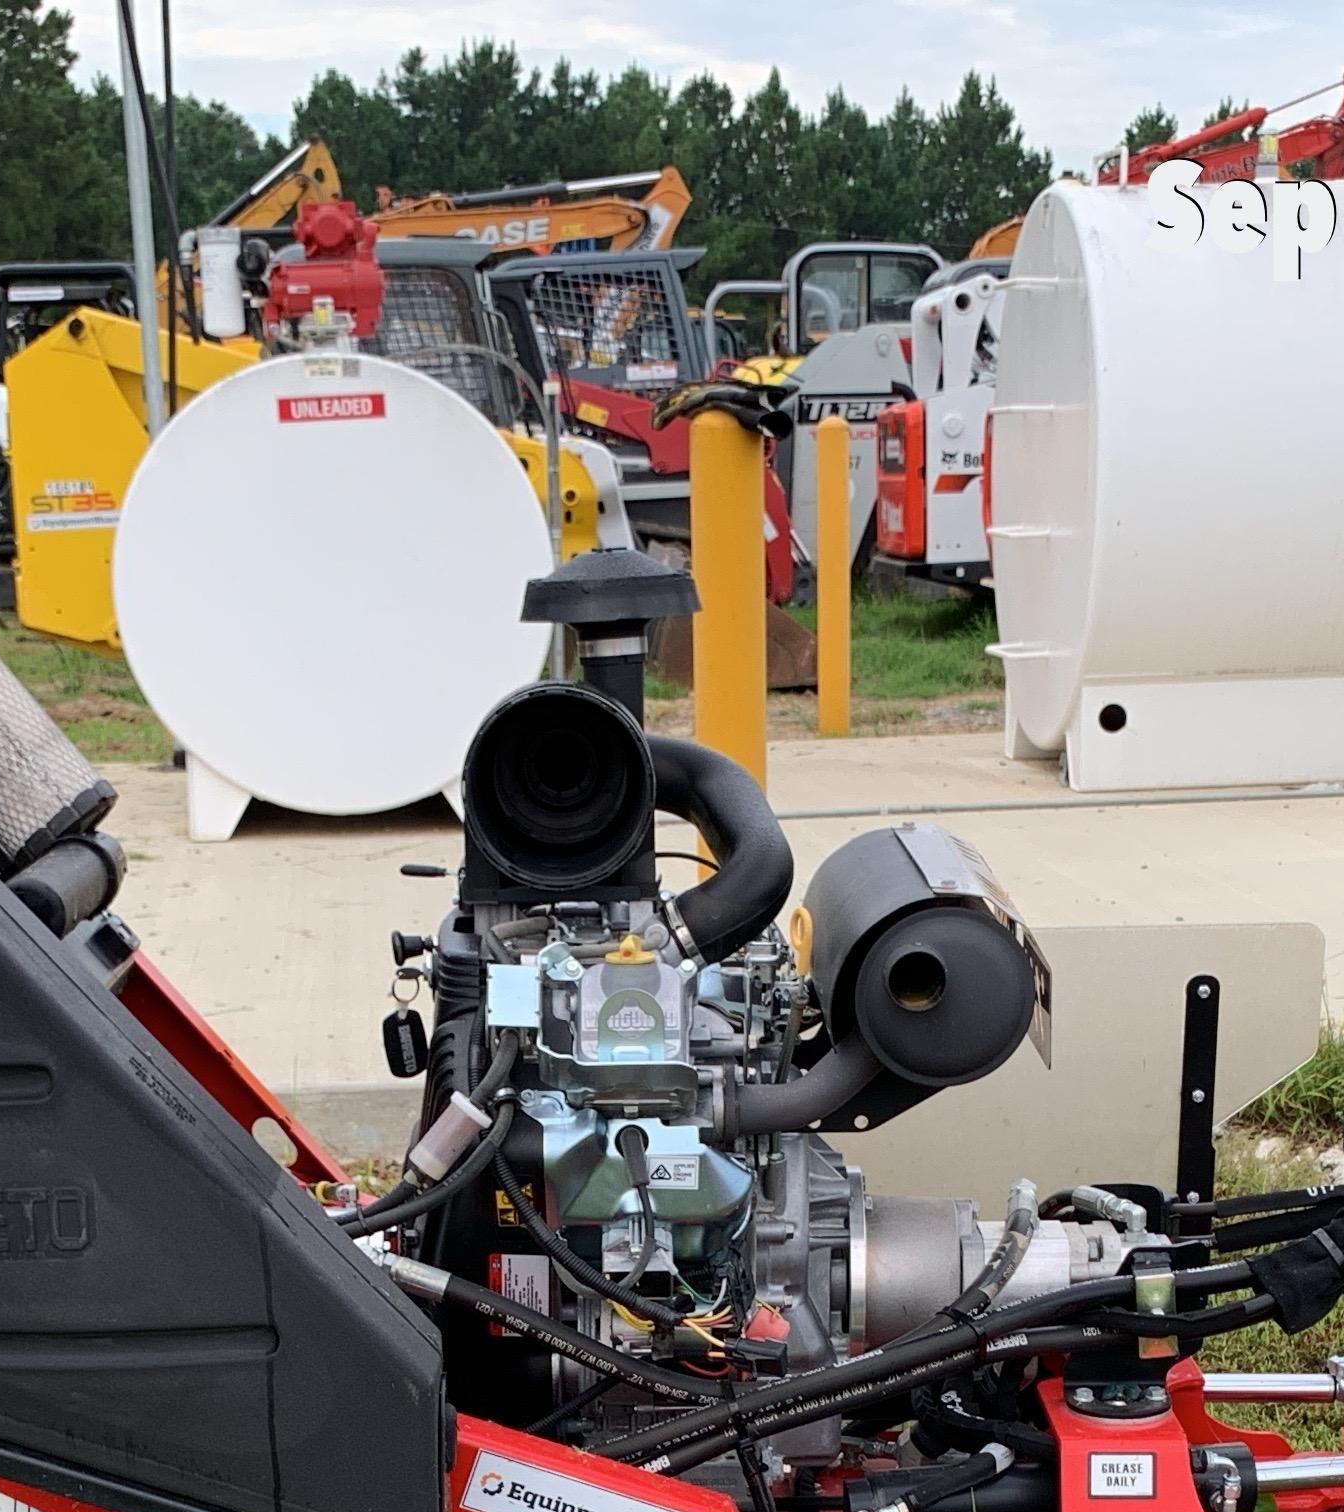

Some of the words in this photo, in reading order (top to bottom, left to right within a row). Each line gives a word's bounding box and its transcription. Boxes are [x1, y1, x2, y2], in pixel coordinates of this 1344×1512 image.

[290, 397, 374, 420] UNLEADED
[30, 492, 117, 514] ST35
[505, 1315, 531, 1333] MSHA
[1101, 1463, 1144, 1474] GREASE
[1106, 1476, 1137, 1487] DAILY
